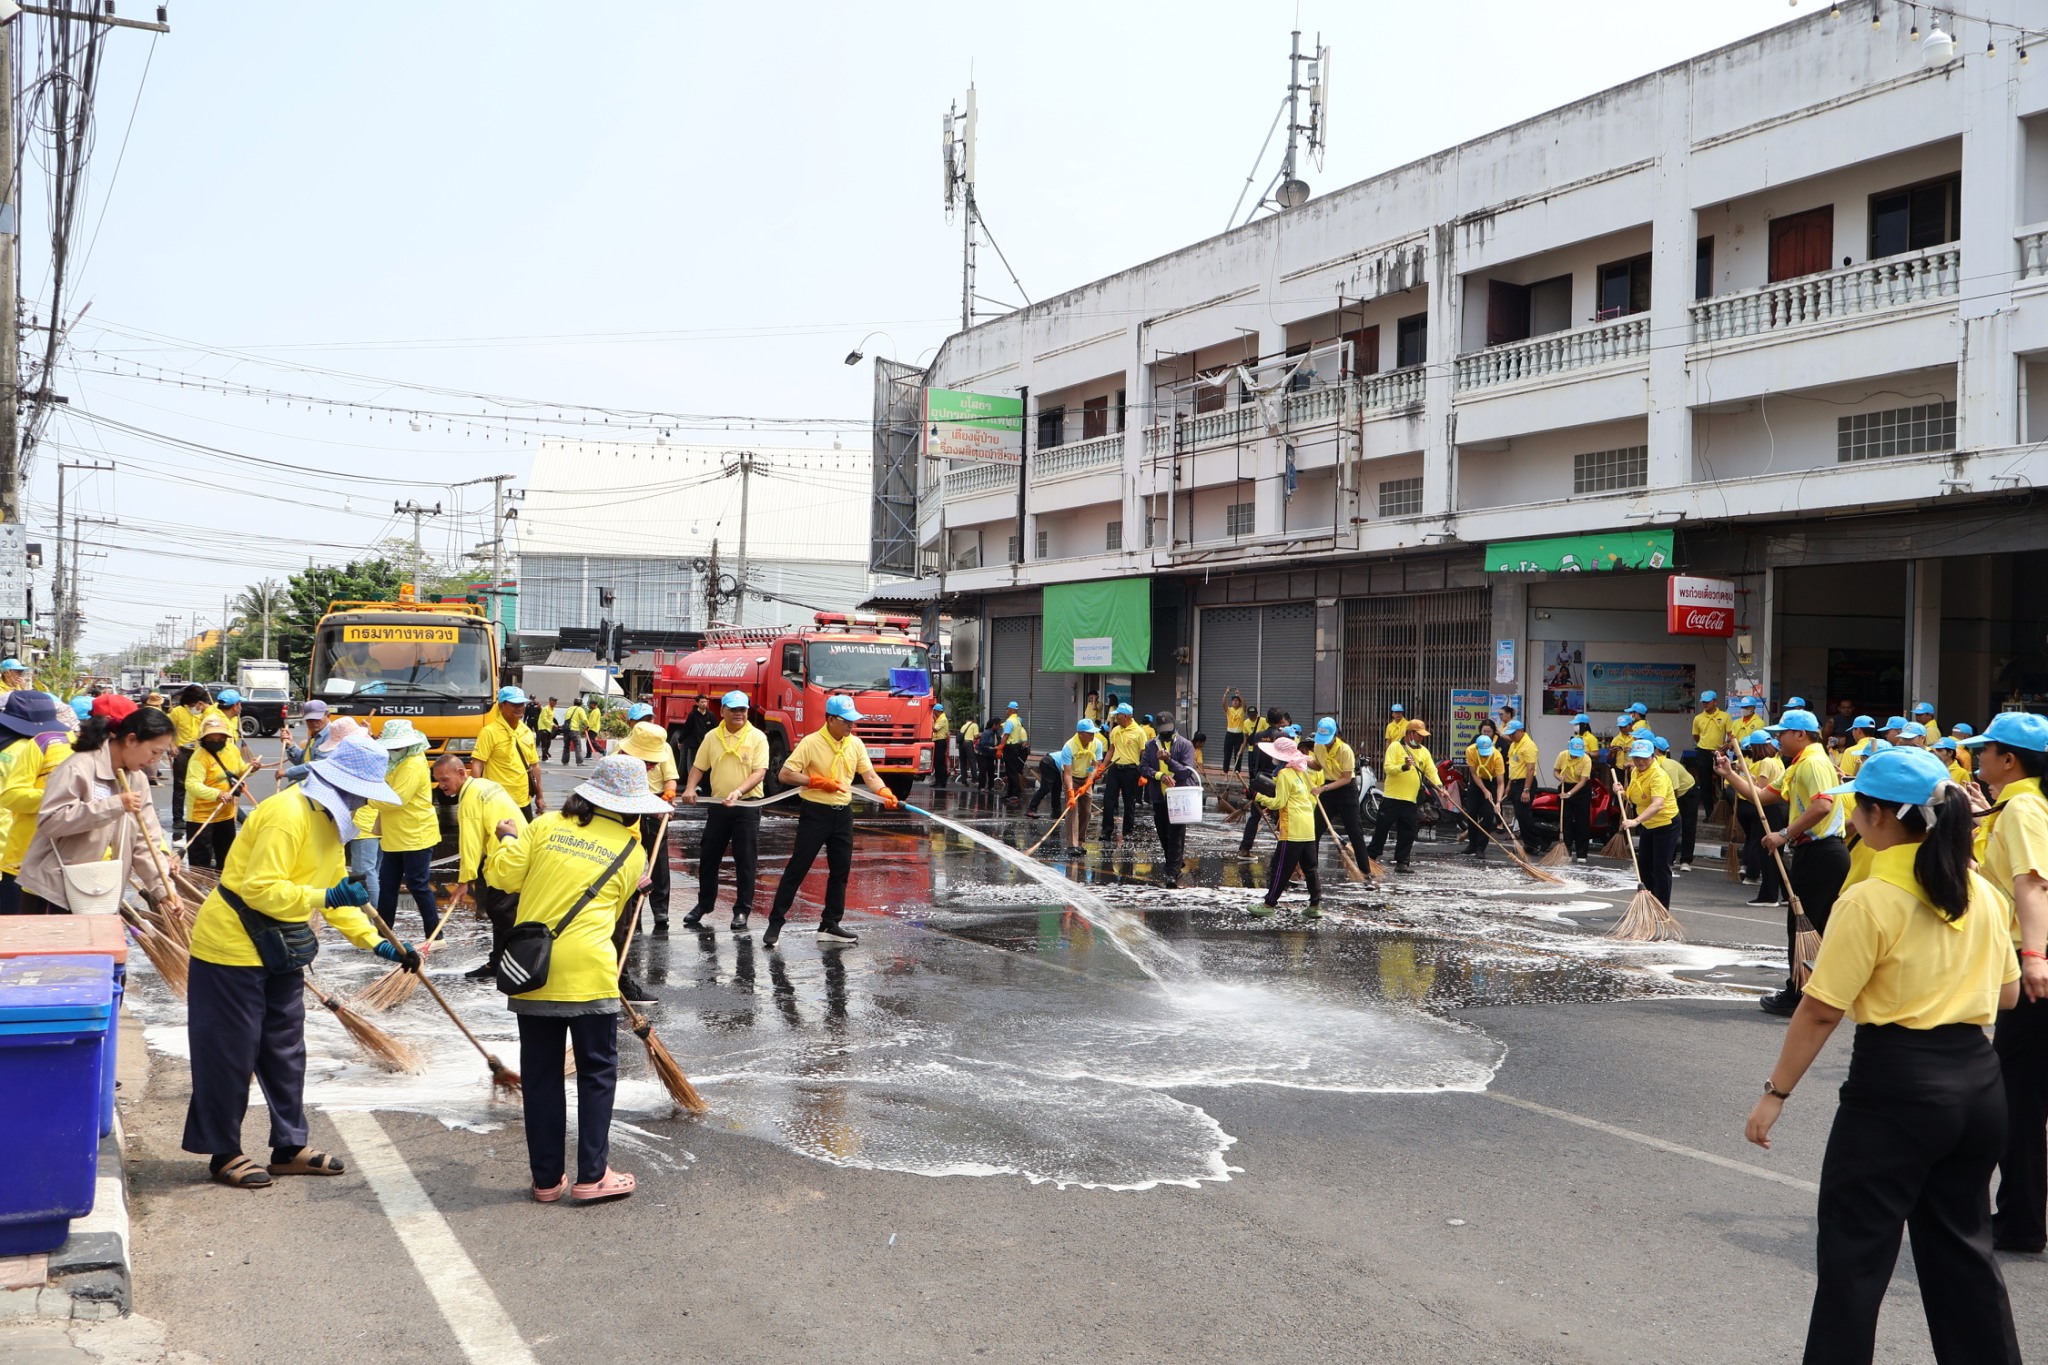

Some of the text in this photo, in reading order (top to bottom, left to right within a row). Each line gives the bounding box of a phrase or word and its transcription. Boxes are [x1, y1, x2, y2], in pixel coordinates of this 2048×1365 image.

[960, 396, 992, 411] ยโสธร
[931, 408, 1020, 427] อุปกรณ์การแพทย
[951, 428, 1000, 447] เตียงผู้ป่วย
[350, 627, 453, 641] กรมทางหลวง
[380, 705, 424, 715] ISUZU
[863, 714, 892, 722] SUZU
